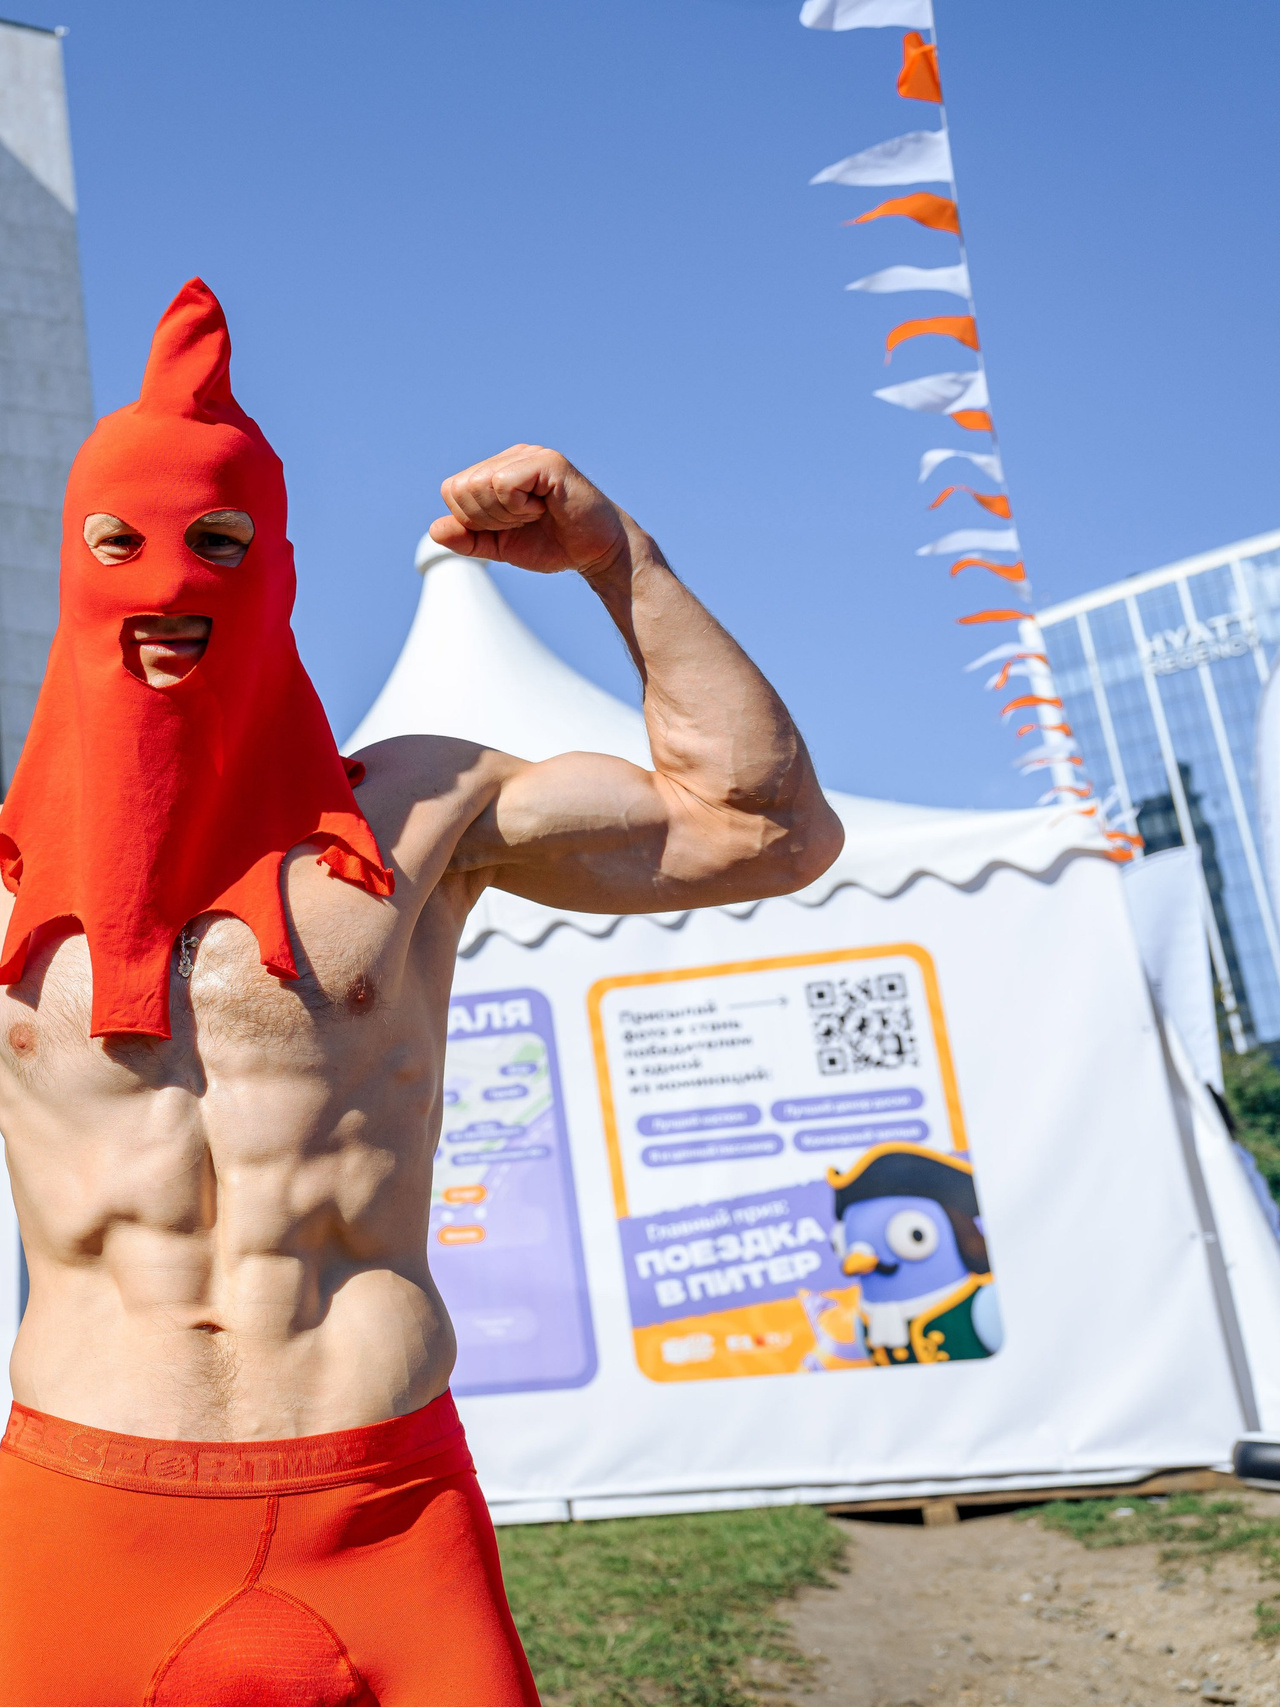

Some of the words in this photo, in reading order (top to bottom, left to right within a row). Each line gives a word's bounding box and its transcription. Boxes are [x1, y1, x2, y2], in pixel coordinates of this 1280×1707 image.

[634, 1217, 826, 1279] ПОЕЗДКА
[655, 1279, 688, 1308] В
[686, 1250, 822, 1302] ПИТЕР
